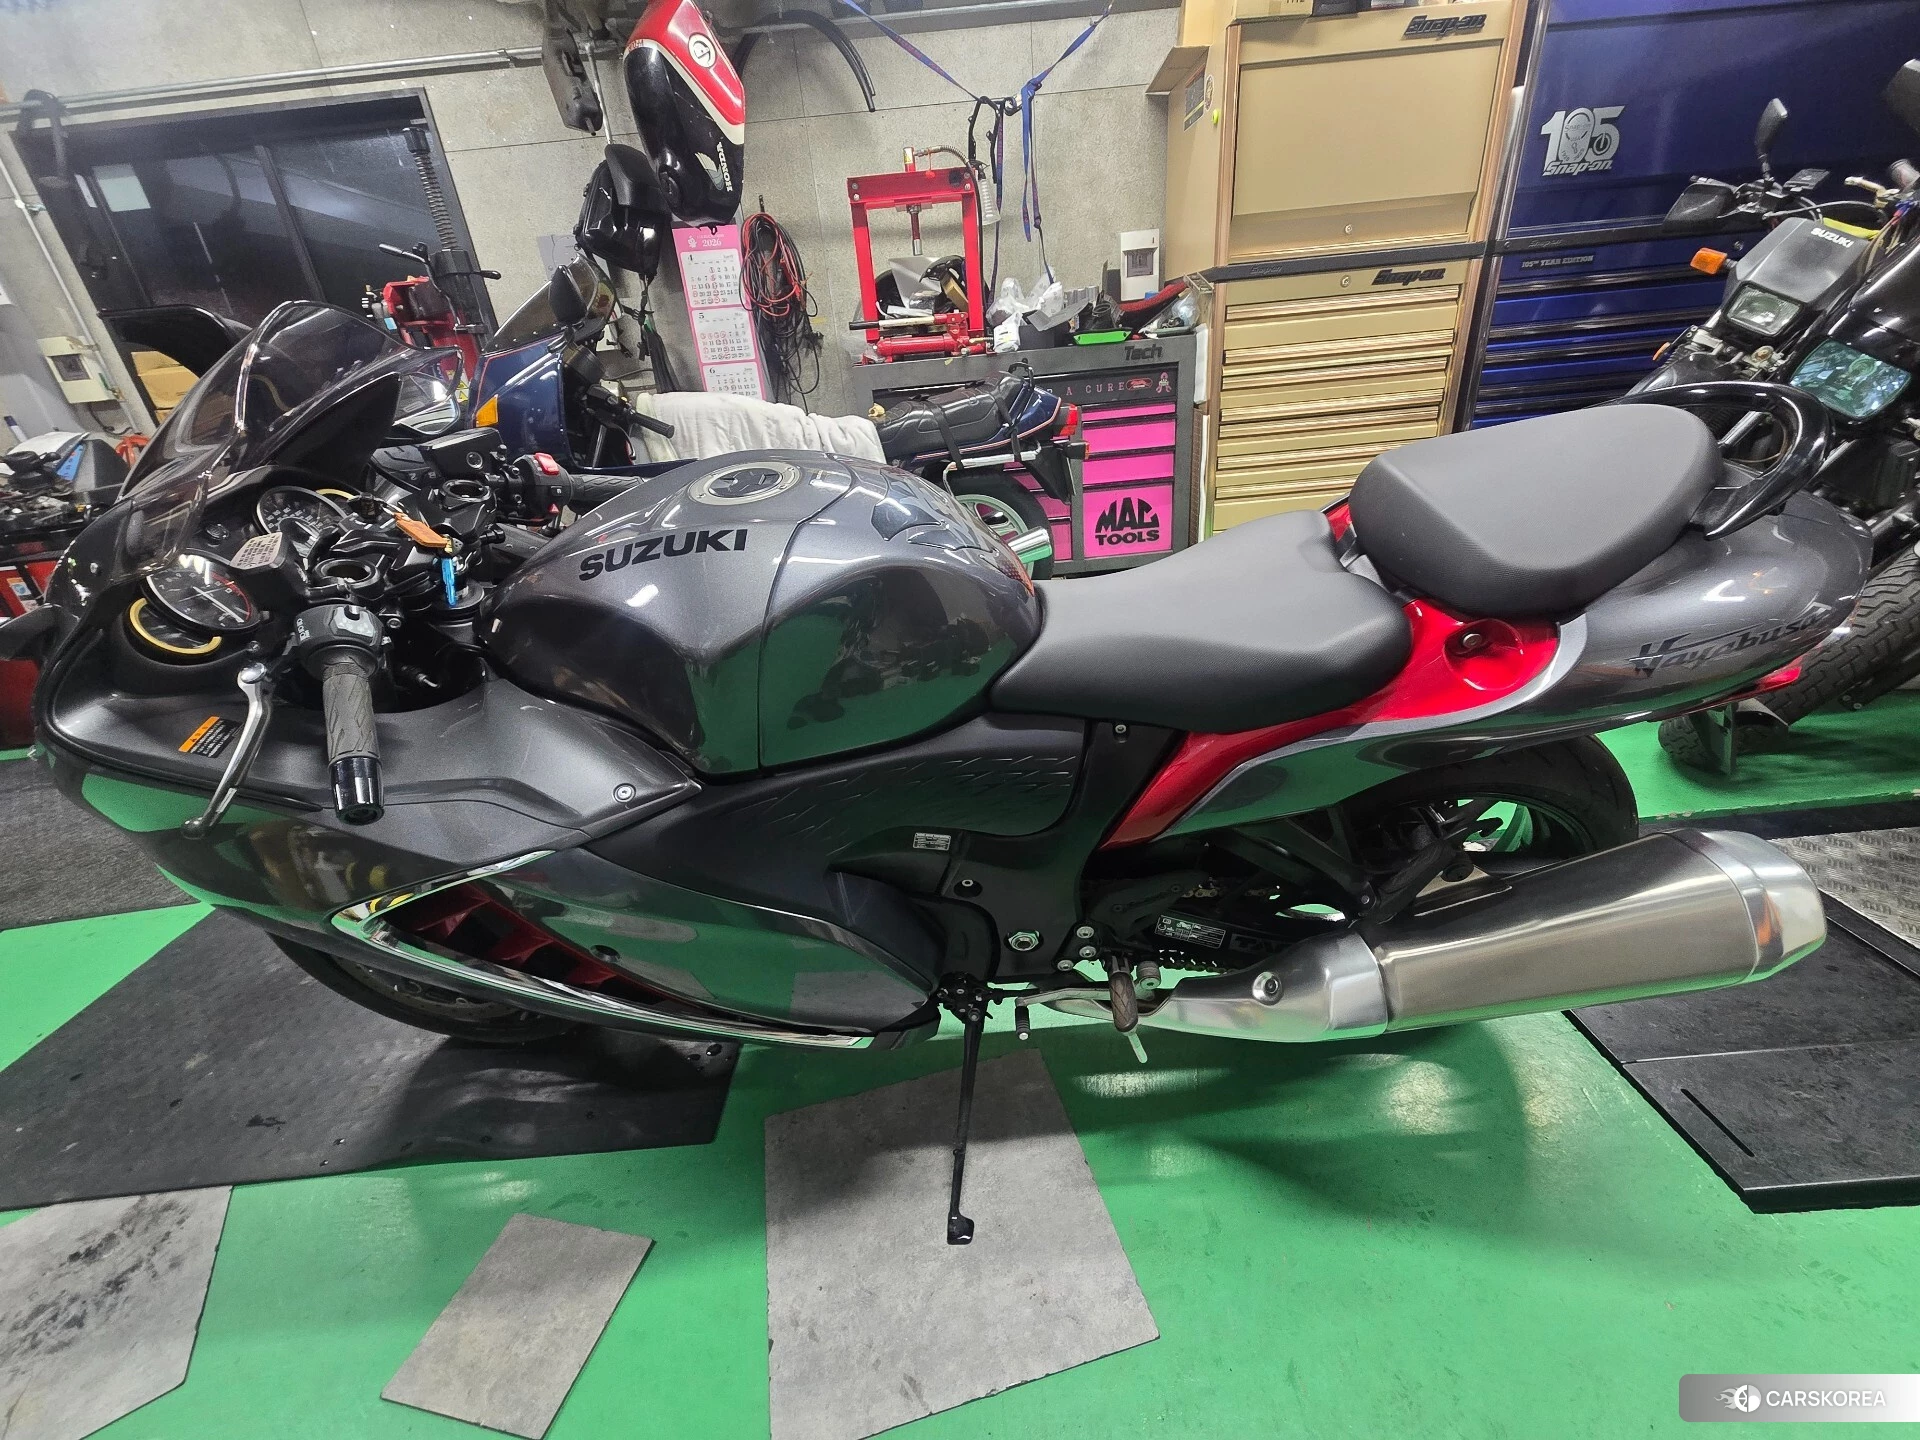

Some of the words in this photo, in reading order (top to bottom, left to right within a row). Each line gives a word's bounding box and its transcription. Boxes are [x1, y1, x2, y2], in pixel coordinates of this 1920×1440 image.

[1404, 14, 1487, 36] Snap-on
[1541, 106, 1625, 172] 105
[717, 142, 733, 192] HONDA
[1811, 228, 1854, 248] SUZUKI
[1540, 258, 1561, 267] YEAR
[1562, 255, 1594, 264] EDITION
[1371, 268, 1446, 285] Snap-on
[1124, 344, 1163, 361] Tech
[1066, 386, 1073, 395] A
[1085, 382, 1125, 393] CURE
[1095, 497, 1160, 533] MAC
[1095, 529, 1160, 546] TOOLS
[579, 529, 748, 581] SUZUKI
[1625, 602, 1832, 678] Hayabusa
